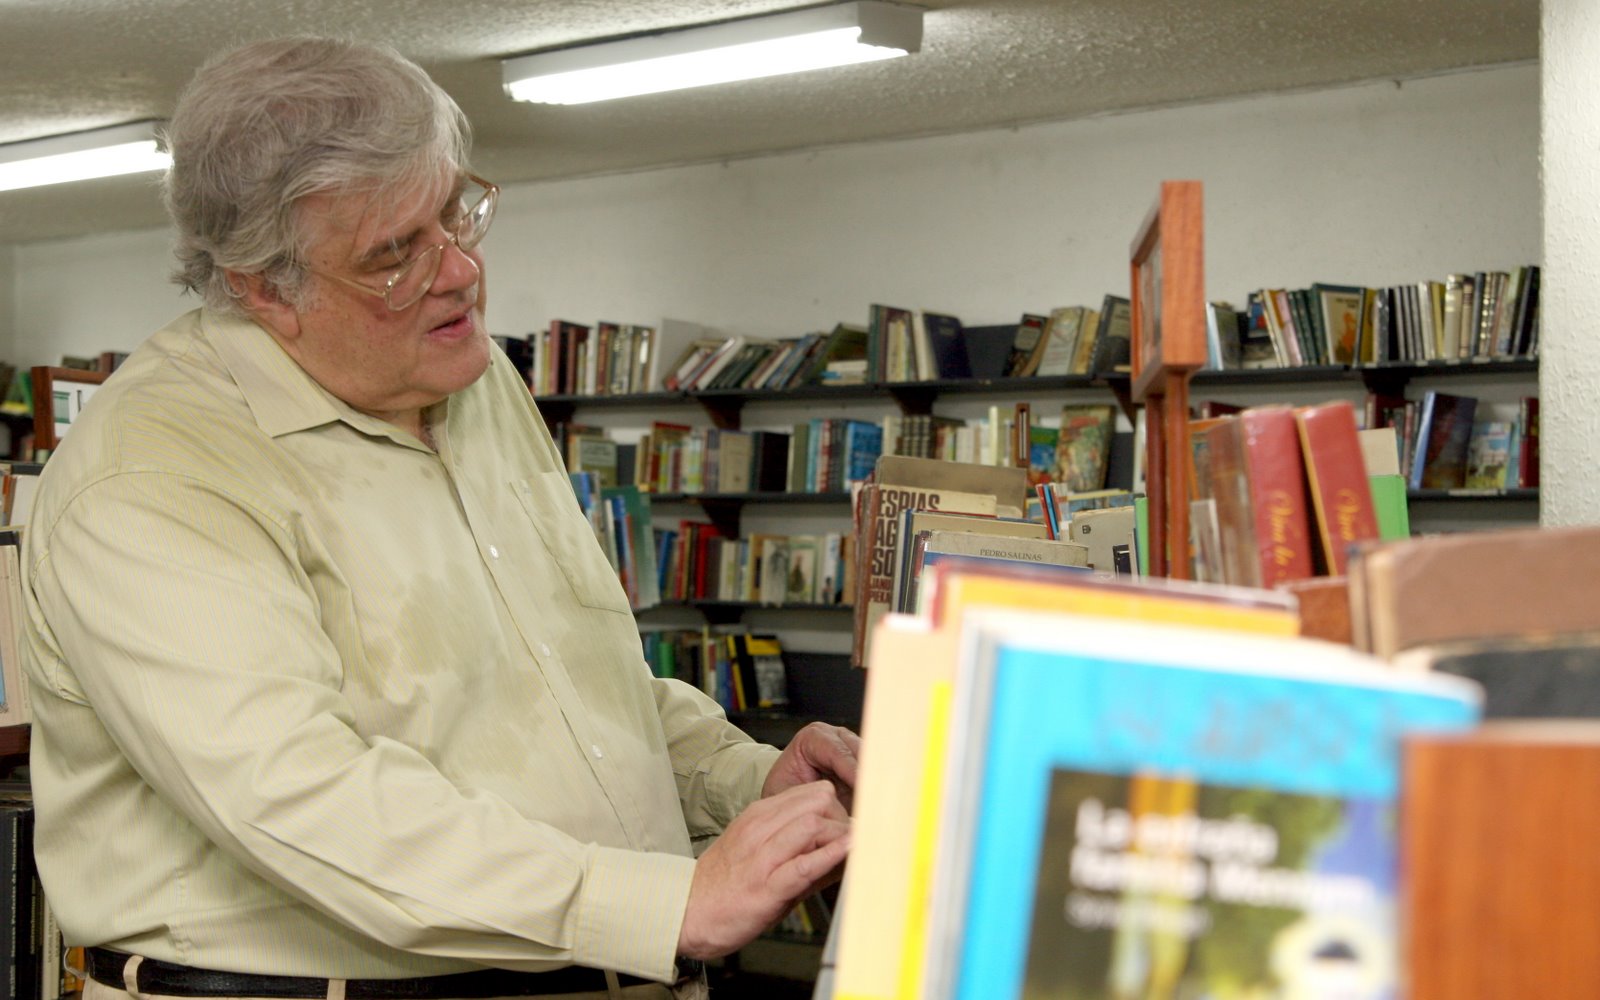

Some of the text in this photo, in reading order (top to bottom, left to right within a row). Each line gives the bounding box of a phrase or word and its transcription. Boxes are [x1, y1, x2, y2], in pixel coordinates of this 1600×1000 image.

[879, 489, 940, 518] ESPIAS
[980, 549, 1042, 561] PEDRO SALINAS
